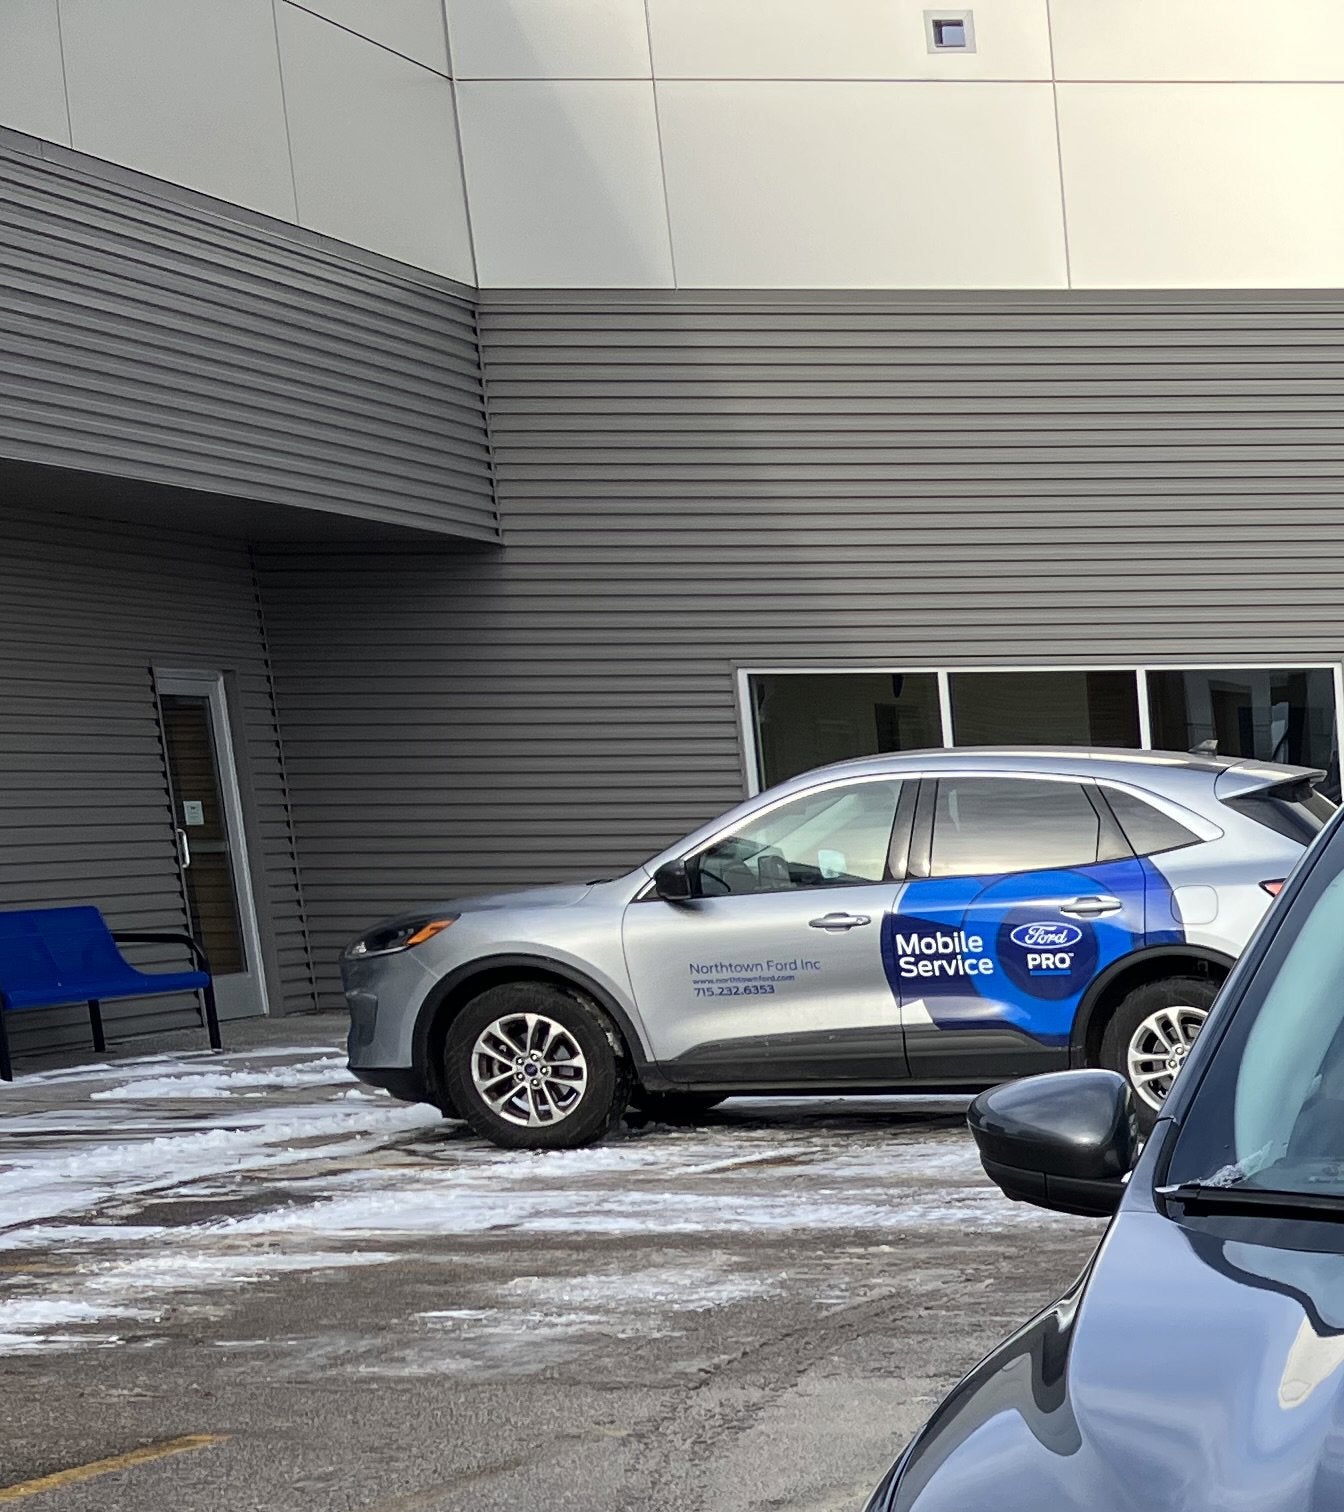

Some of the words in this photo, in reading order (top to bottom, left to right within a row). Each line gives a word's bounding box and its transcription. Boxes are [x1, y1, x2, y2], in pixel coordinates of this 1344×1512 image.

[896, 929, 984, 955] Mobile
[1024, 925, 1068, 944] Ford
[689, 962, 764, 975] Northtown
[766, 959, 798, 972] Ford
[800, 959, 822, 970] Inc
[899, 955, 996, 978] Service
[694, 984, 775, 997] 715.232.6353
